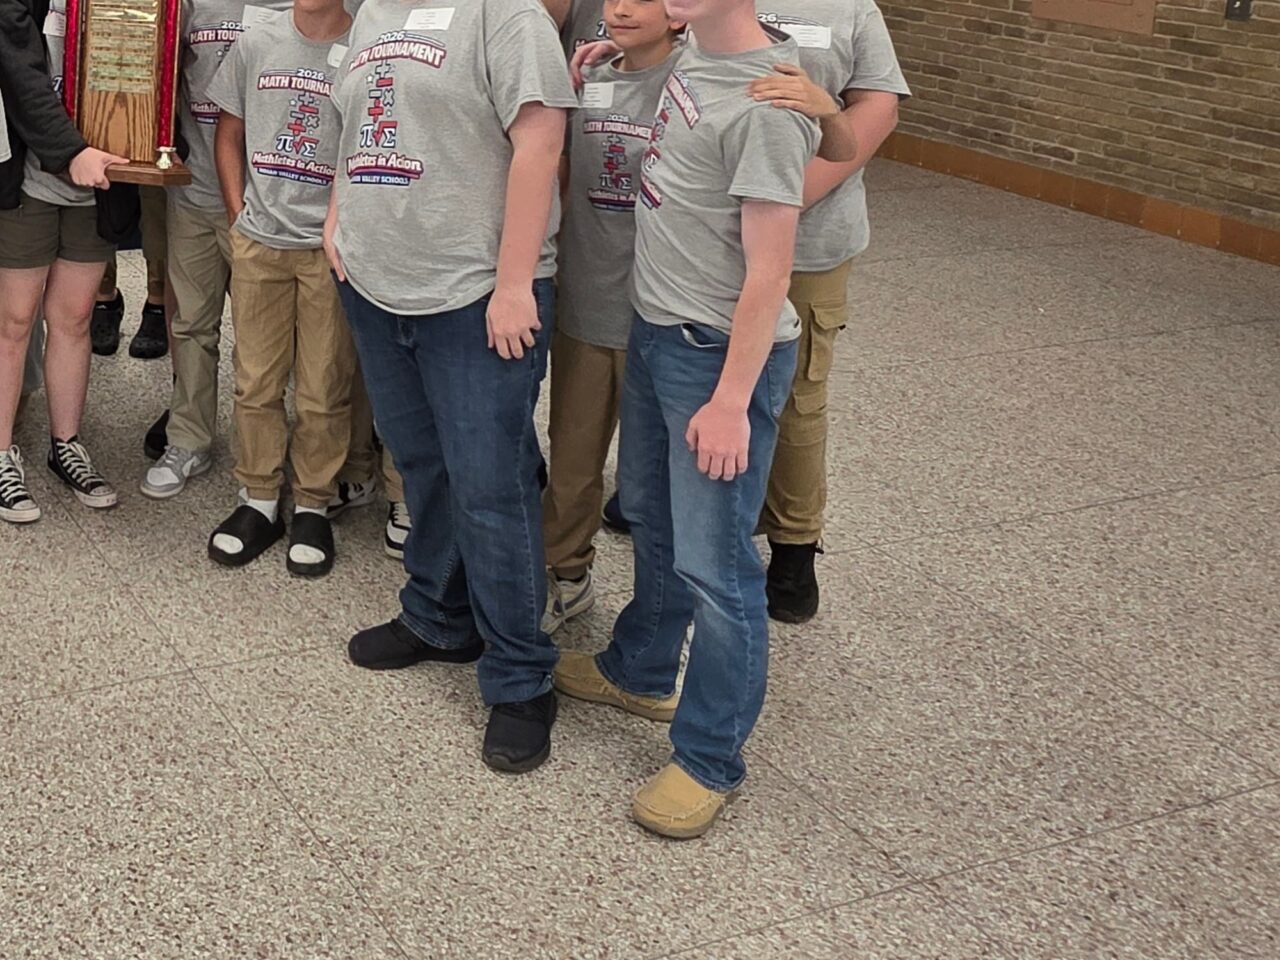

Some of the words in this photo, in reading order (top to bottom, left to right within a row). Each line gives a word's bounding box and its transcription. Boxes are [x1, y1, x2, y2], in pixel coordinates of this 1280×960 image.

[757, 13, 778, 23] 26
[221, 21, 241, 30] 202
[370, 42, 445, 67] TOURNAMENT
[297, 68, 325, 81] 2026
[259, 76, 288, 90] MATH
[290, 77, 331, 96] TOURNA
[253, 152, 296, 167] Mathletes
